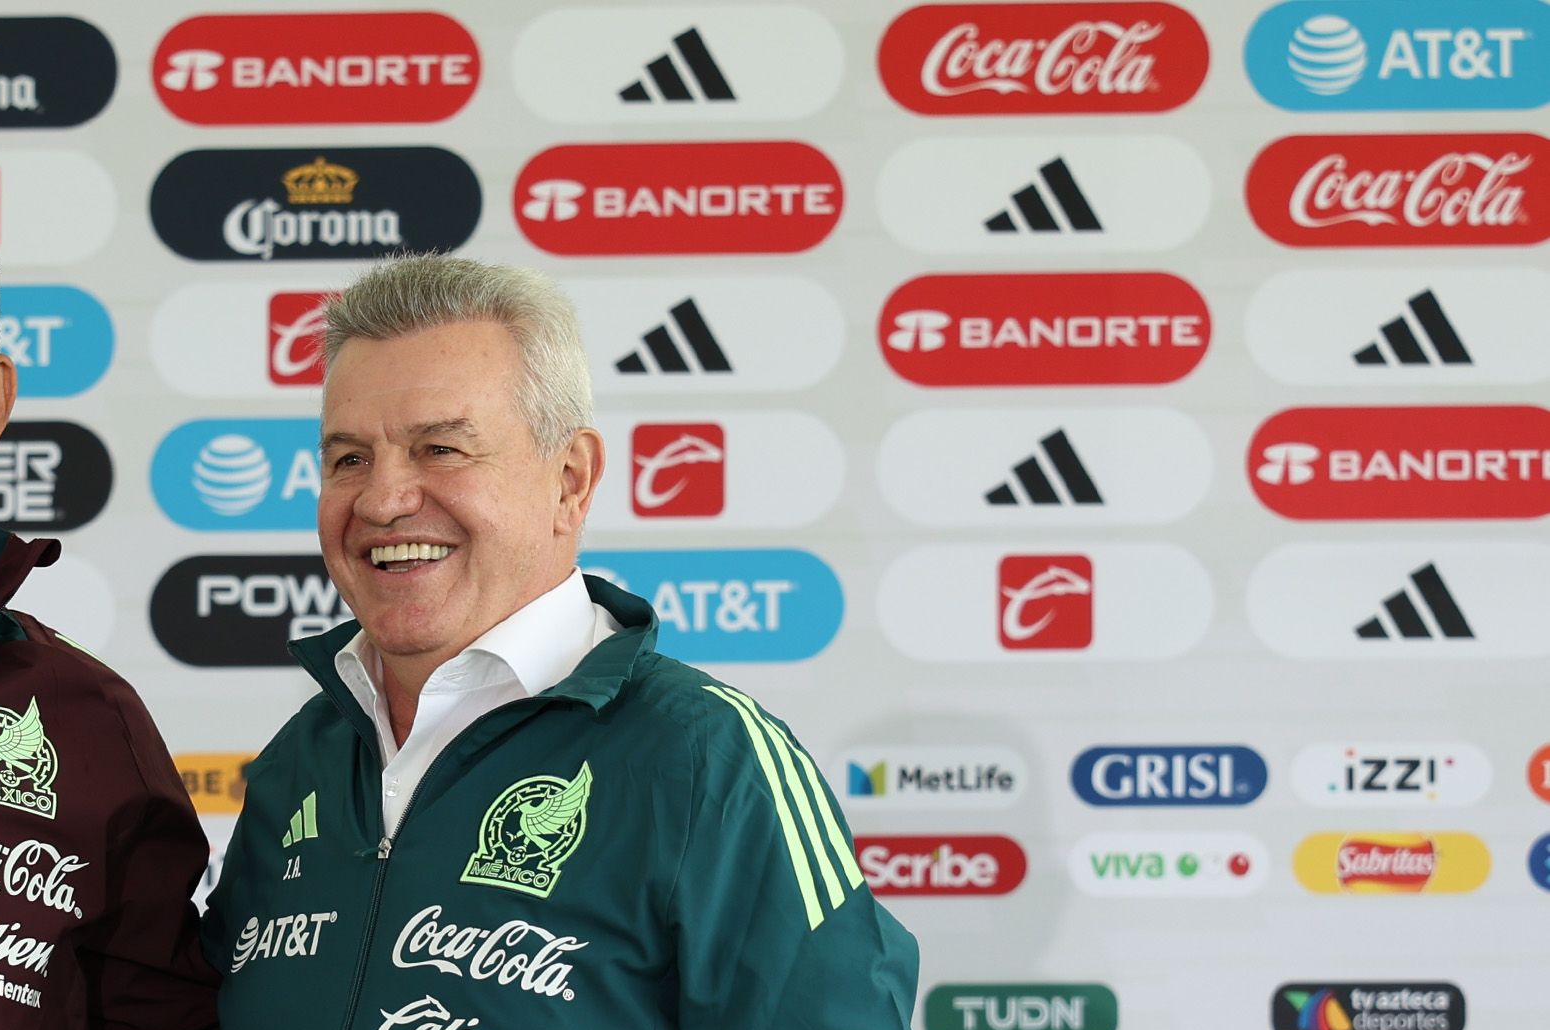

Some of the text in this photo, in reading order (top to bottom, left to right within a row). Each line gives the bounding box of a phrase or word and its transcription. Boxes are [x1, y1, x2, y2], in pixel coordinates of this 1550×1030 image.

[232, 54, 472, 88] BANORTE
[921, 21, 1165, 96] Coca-Cola
[1379, 29, 1522, 79] AT&T
[594, 184, 834, 218] BANORTE
[1290, 152, 1532, 227] Coca-Cola
[223, 199, 401, 258] Corona
[959, 315, 1201, 348] BANORTE
[197, 575, 352, 617] POW
[653, 579, 792, 632] AT&T
[897, 764, 1013, 792] MetLife
[1091, 753, 1234, 799] GRISI
[282, 856, 302, 880] J.A.
[470, 858, 551, 888] MÉXICO
[860, 844, 998, 888] Scribe
[1338, 847, 1433, 878] Sabritas
[251, 912, 330, 960] AT&T
[392, 904, 590, 997] Coca-Cola
[954, 996, 1084, 1030] TUDN
[1351, 988, 1448, 1010] tv azteca
